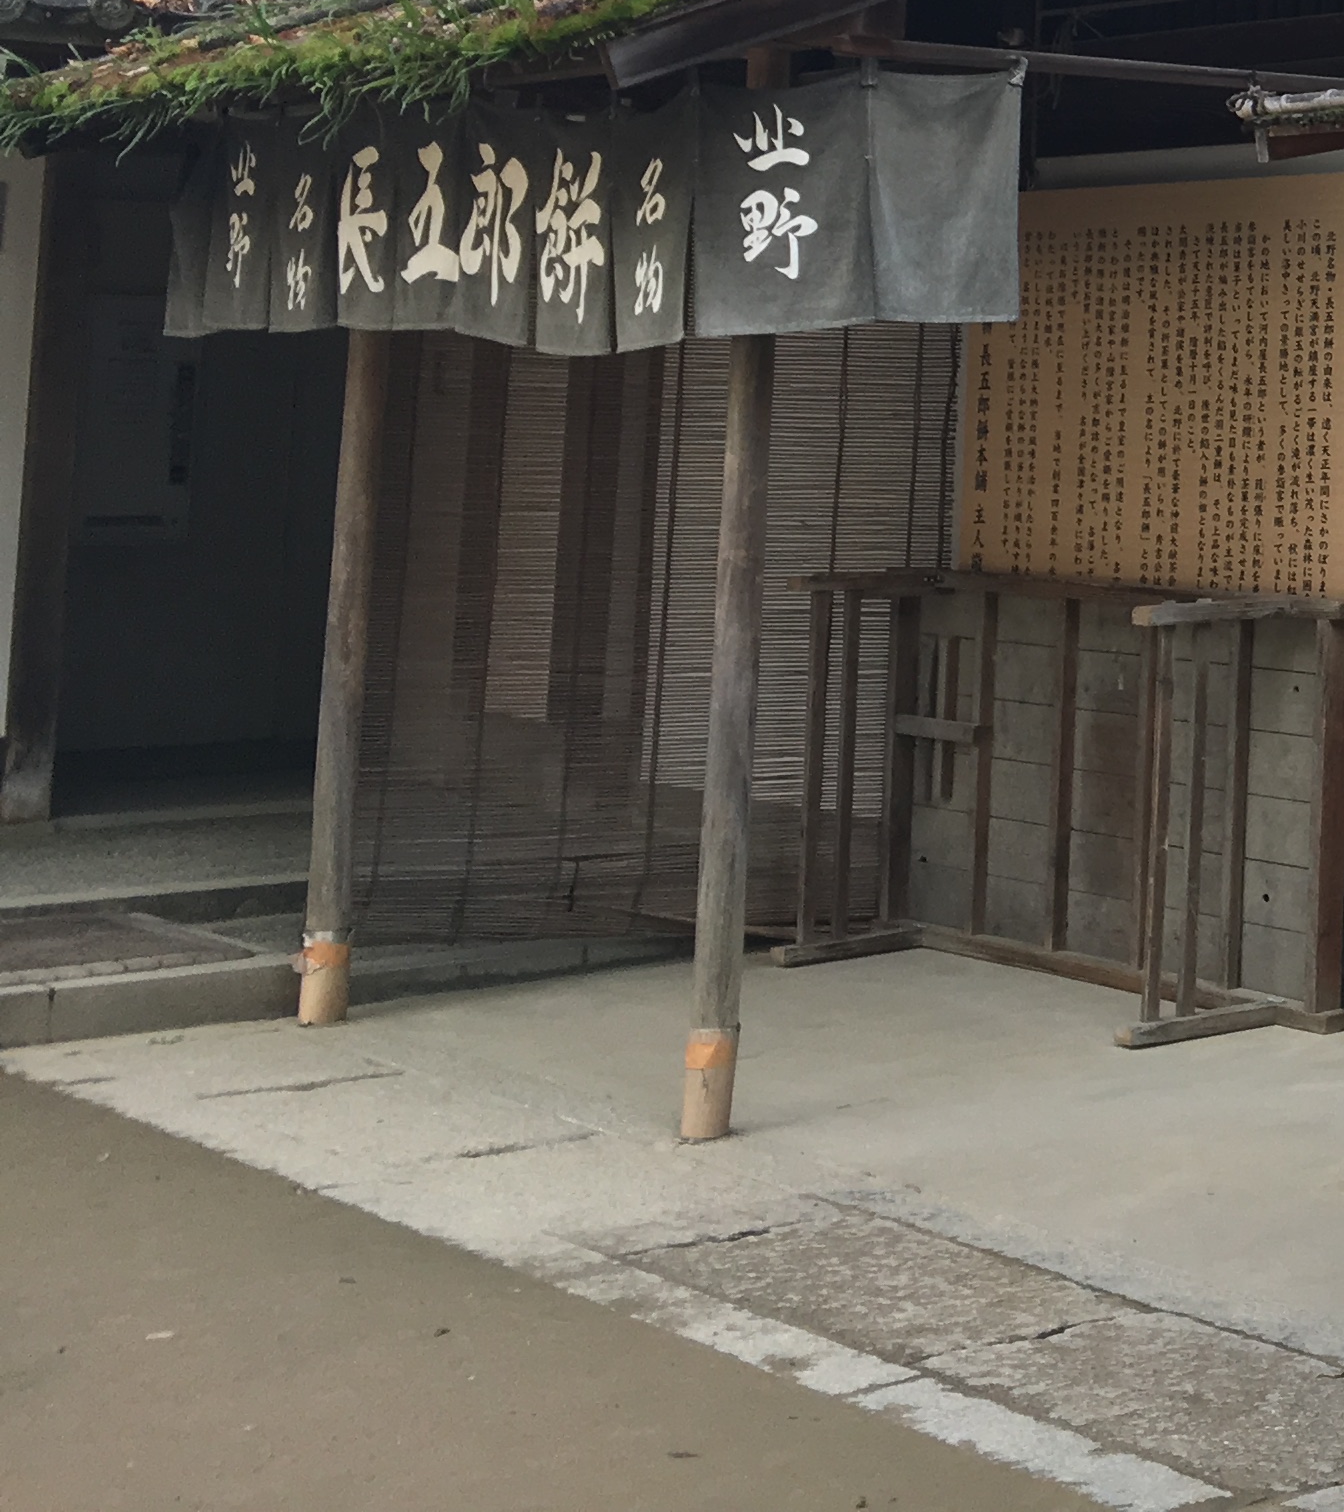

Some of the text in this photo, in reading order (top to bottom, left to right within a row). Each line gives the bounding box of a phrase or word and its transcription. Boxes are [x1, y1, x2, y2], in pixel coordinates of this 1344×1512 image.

[286, 171, 315, 312] 名物
[336, 142, 604, 324] 長五郎餅
[633, 156, 664, 318] 名物
